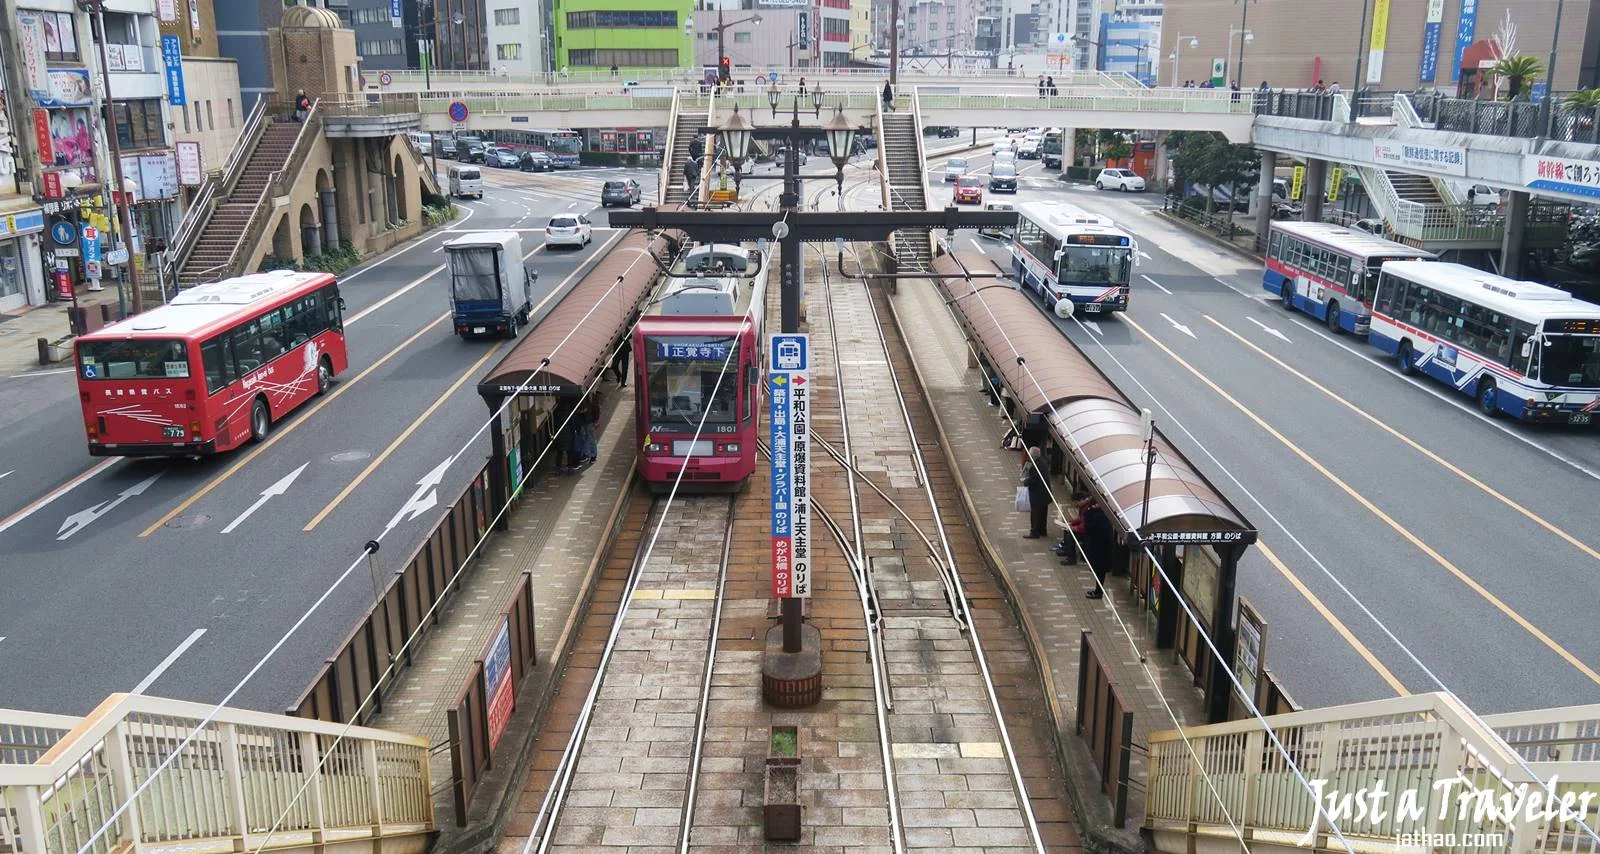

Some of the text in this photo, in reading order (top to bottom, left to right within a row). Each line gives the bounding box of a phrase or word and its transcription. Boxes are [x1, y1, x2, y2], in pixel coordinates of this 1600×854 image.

[1537, 159, 1600, 185] 新幹線で創ろう
[662, 343, 725, 358] 1 正覚寺下
[793, 388, 807, 595] 平和公園・原爆資料館・浦上天主堂 のりば
[775, 513, 787, 533] のりば
[1224, 532, 1242, 540] のりば
[776, 540, 788, 594] めがね橋 のりば
